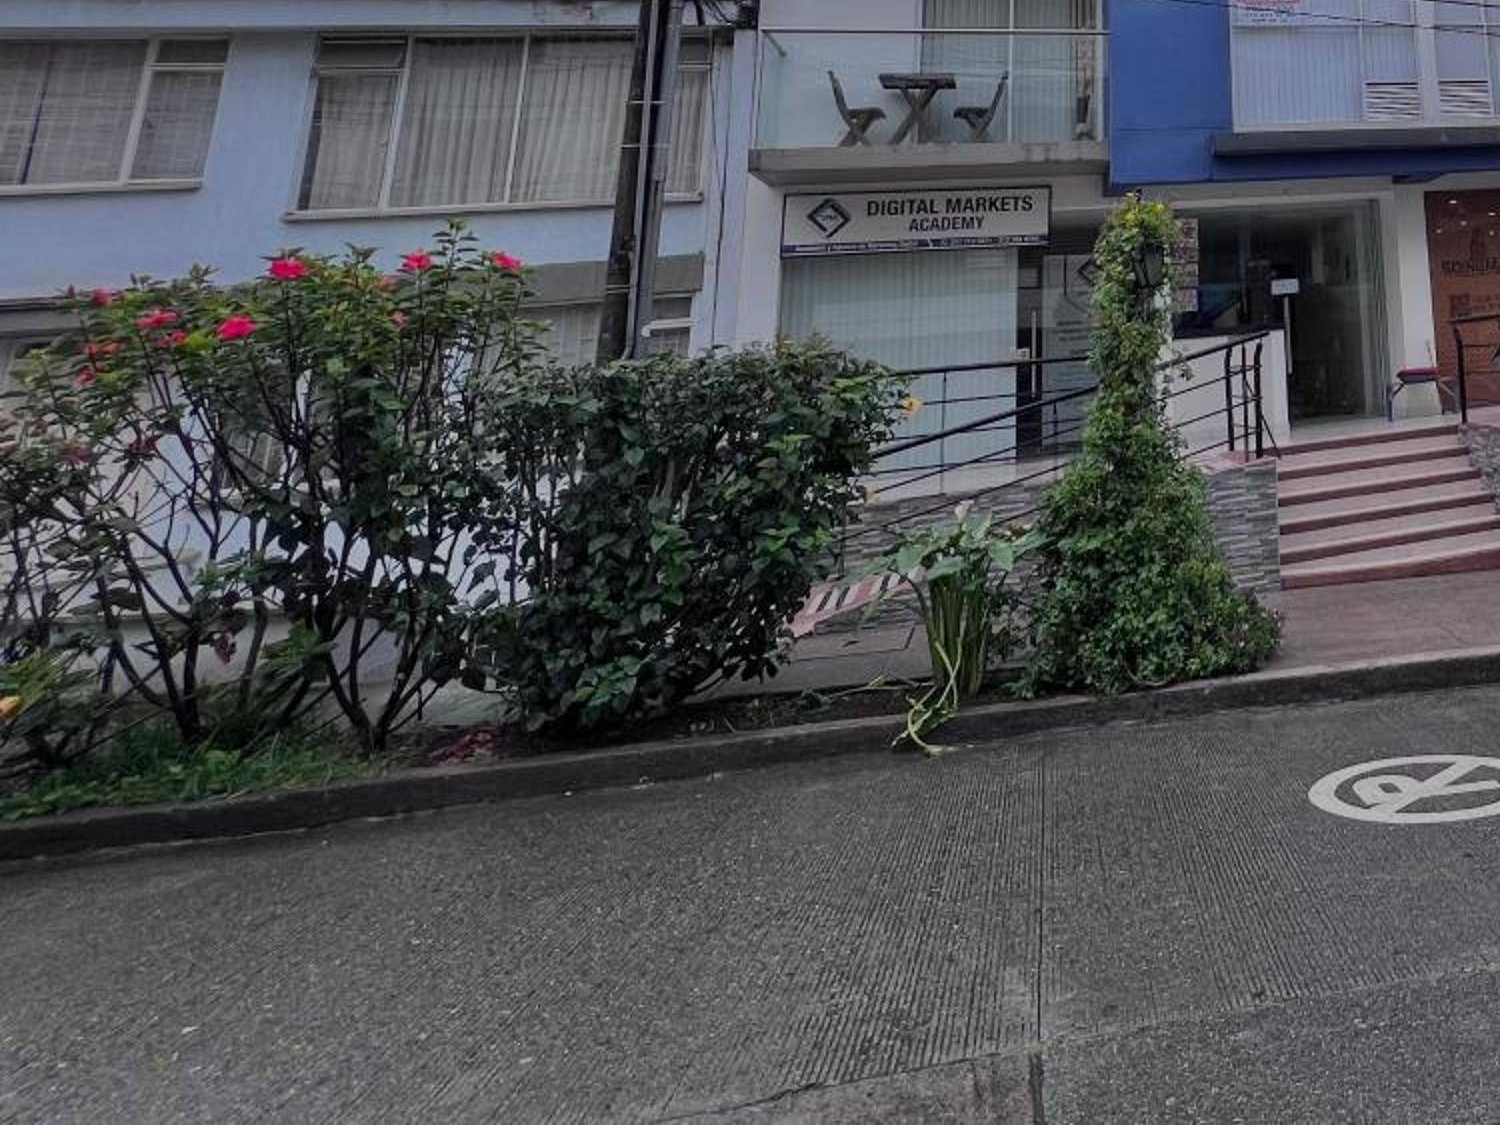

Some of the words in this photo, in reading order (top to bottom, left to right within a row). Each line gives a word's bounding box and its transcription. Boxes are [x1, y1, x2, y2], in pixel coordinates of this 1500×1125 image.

[867, 198, 938, 217] DIGITAL
[945, 194, 1034, 214] MARKETS
[908, 216, 985, 233] ACADEMY
